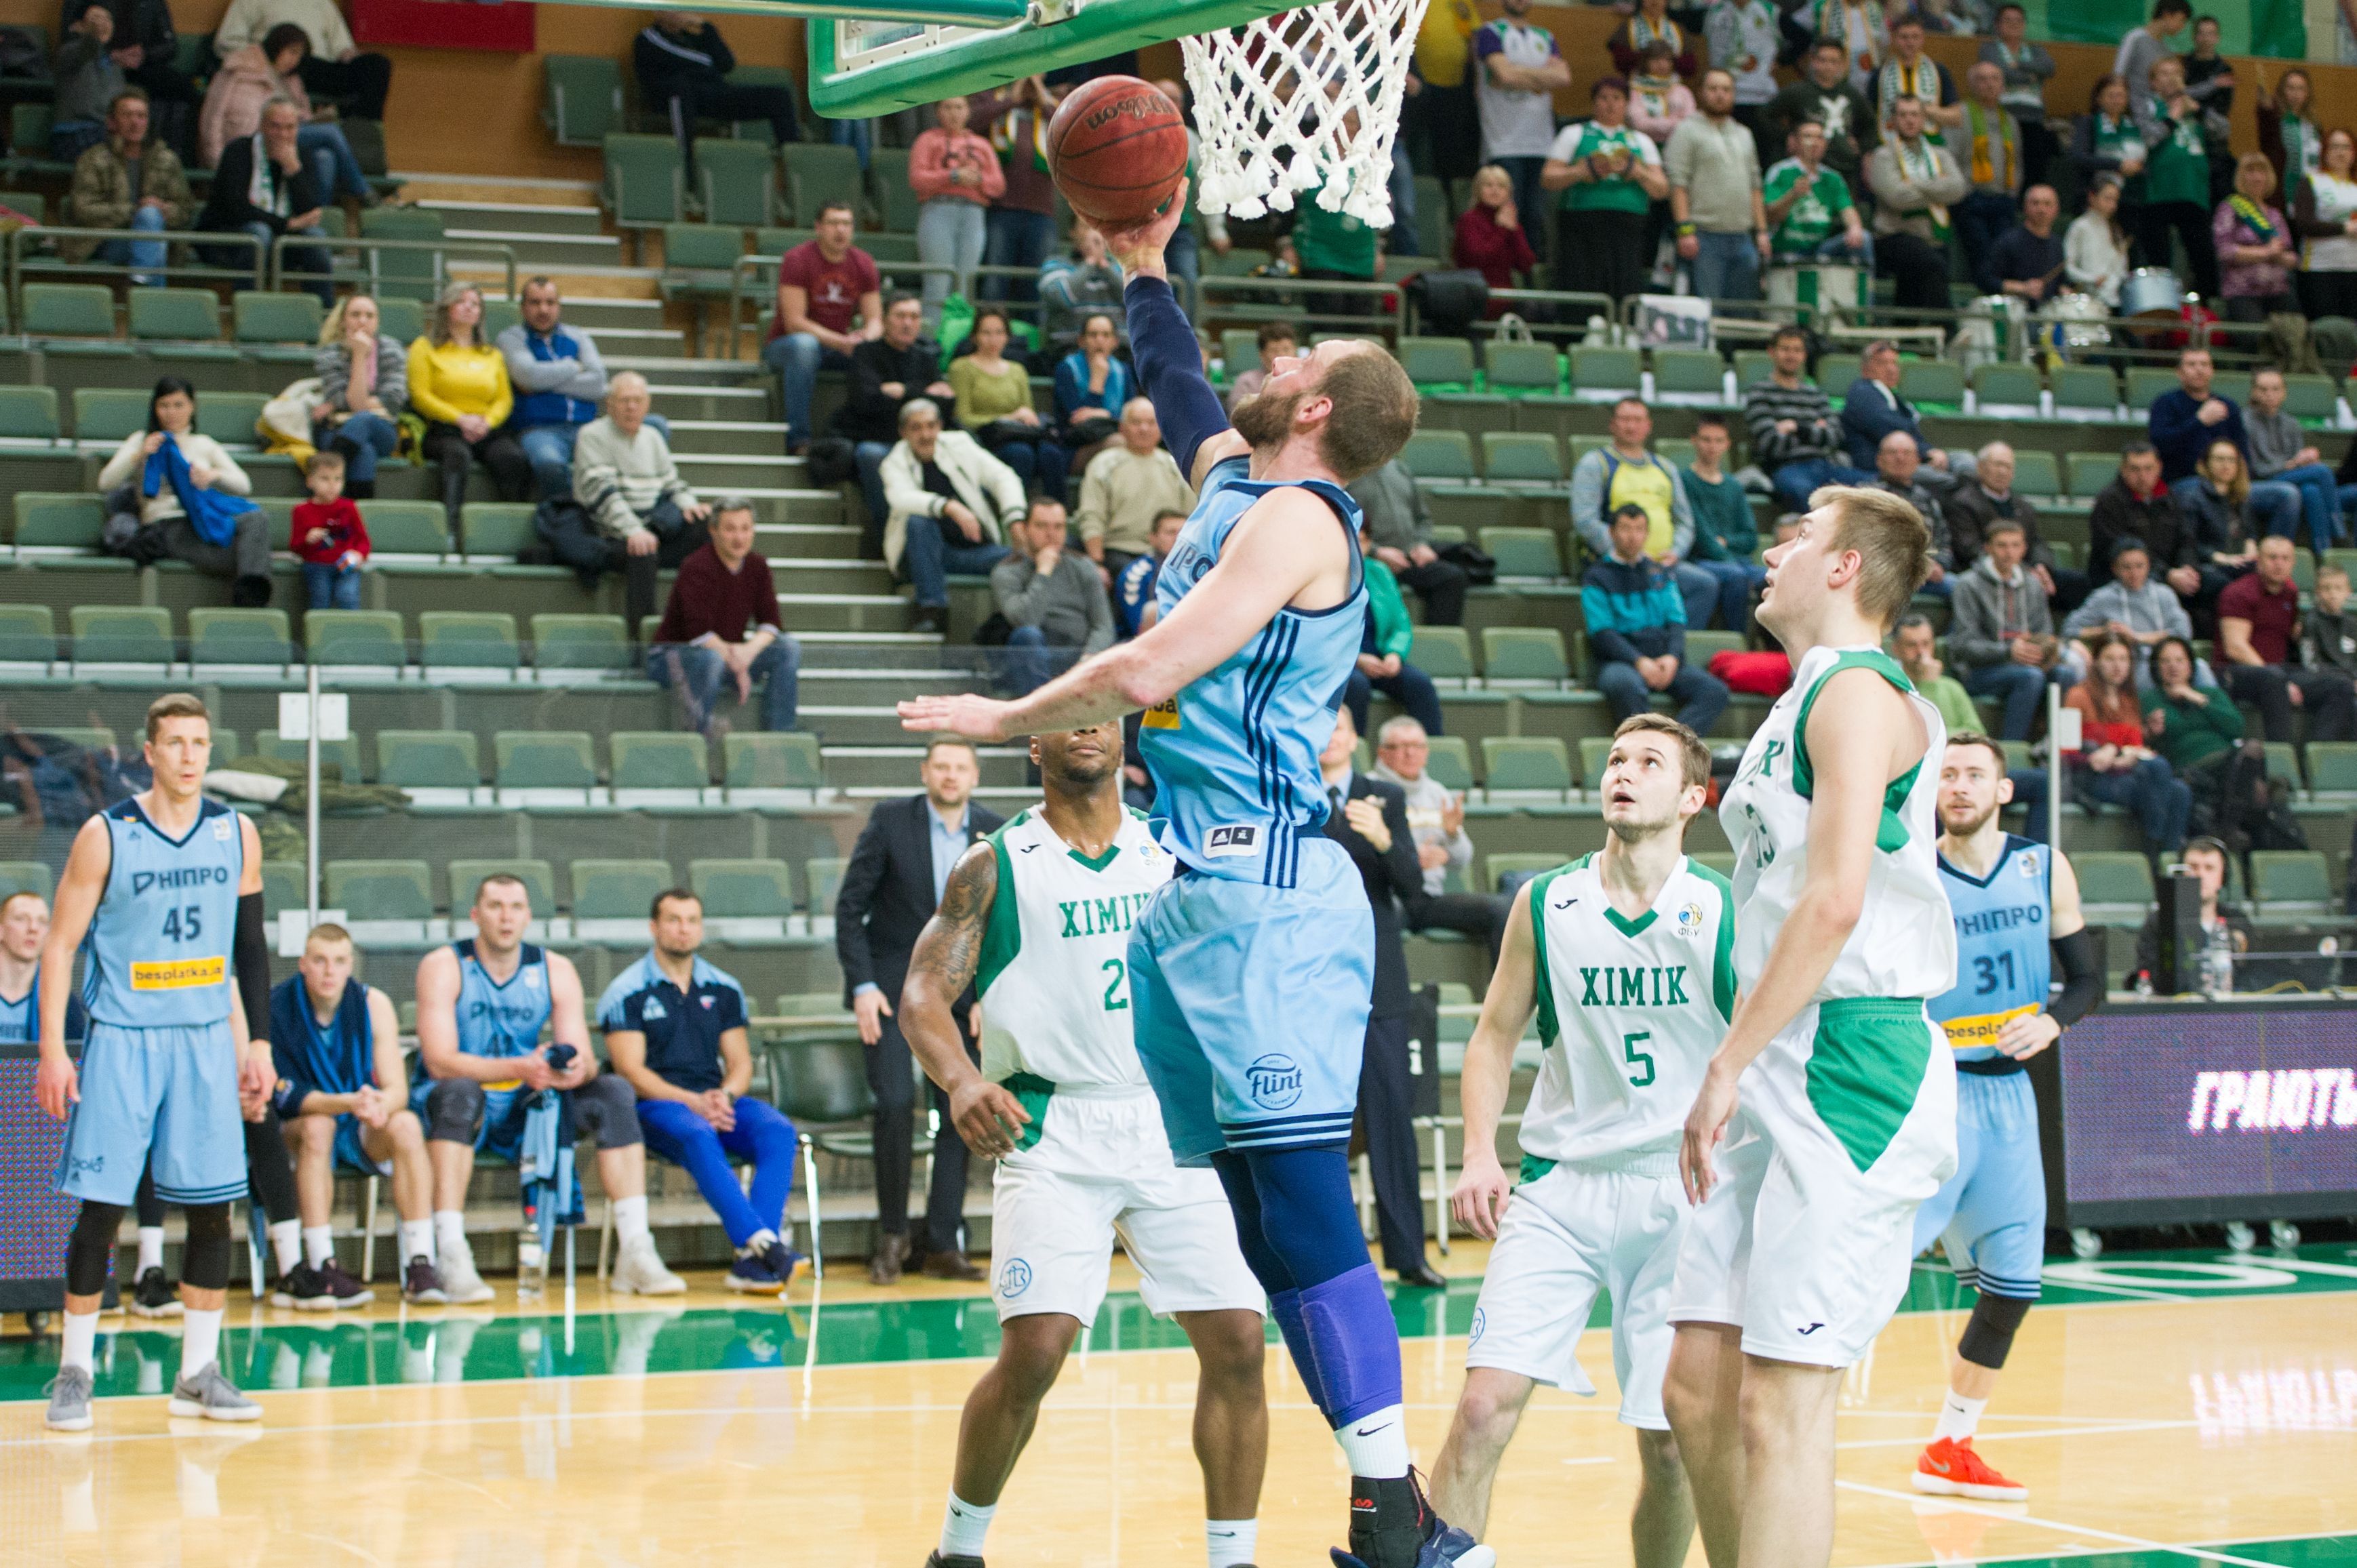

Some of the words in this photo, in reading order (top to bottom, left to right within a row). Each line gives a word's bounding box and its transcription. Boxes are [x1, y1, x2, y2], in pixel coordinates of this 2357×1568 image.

[162, 906, 201, 942] 45
[1102, 959, 1128, 1010] 2
[1973, 950, 2015, 995] 31
[1623, 1032, 1656, 1087] 5
